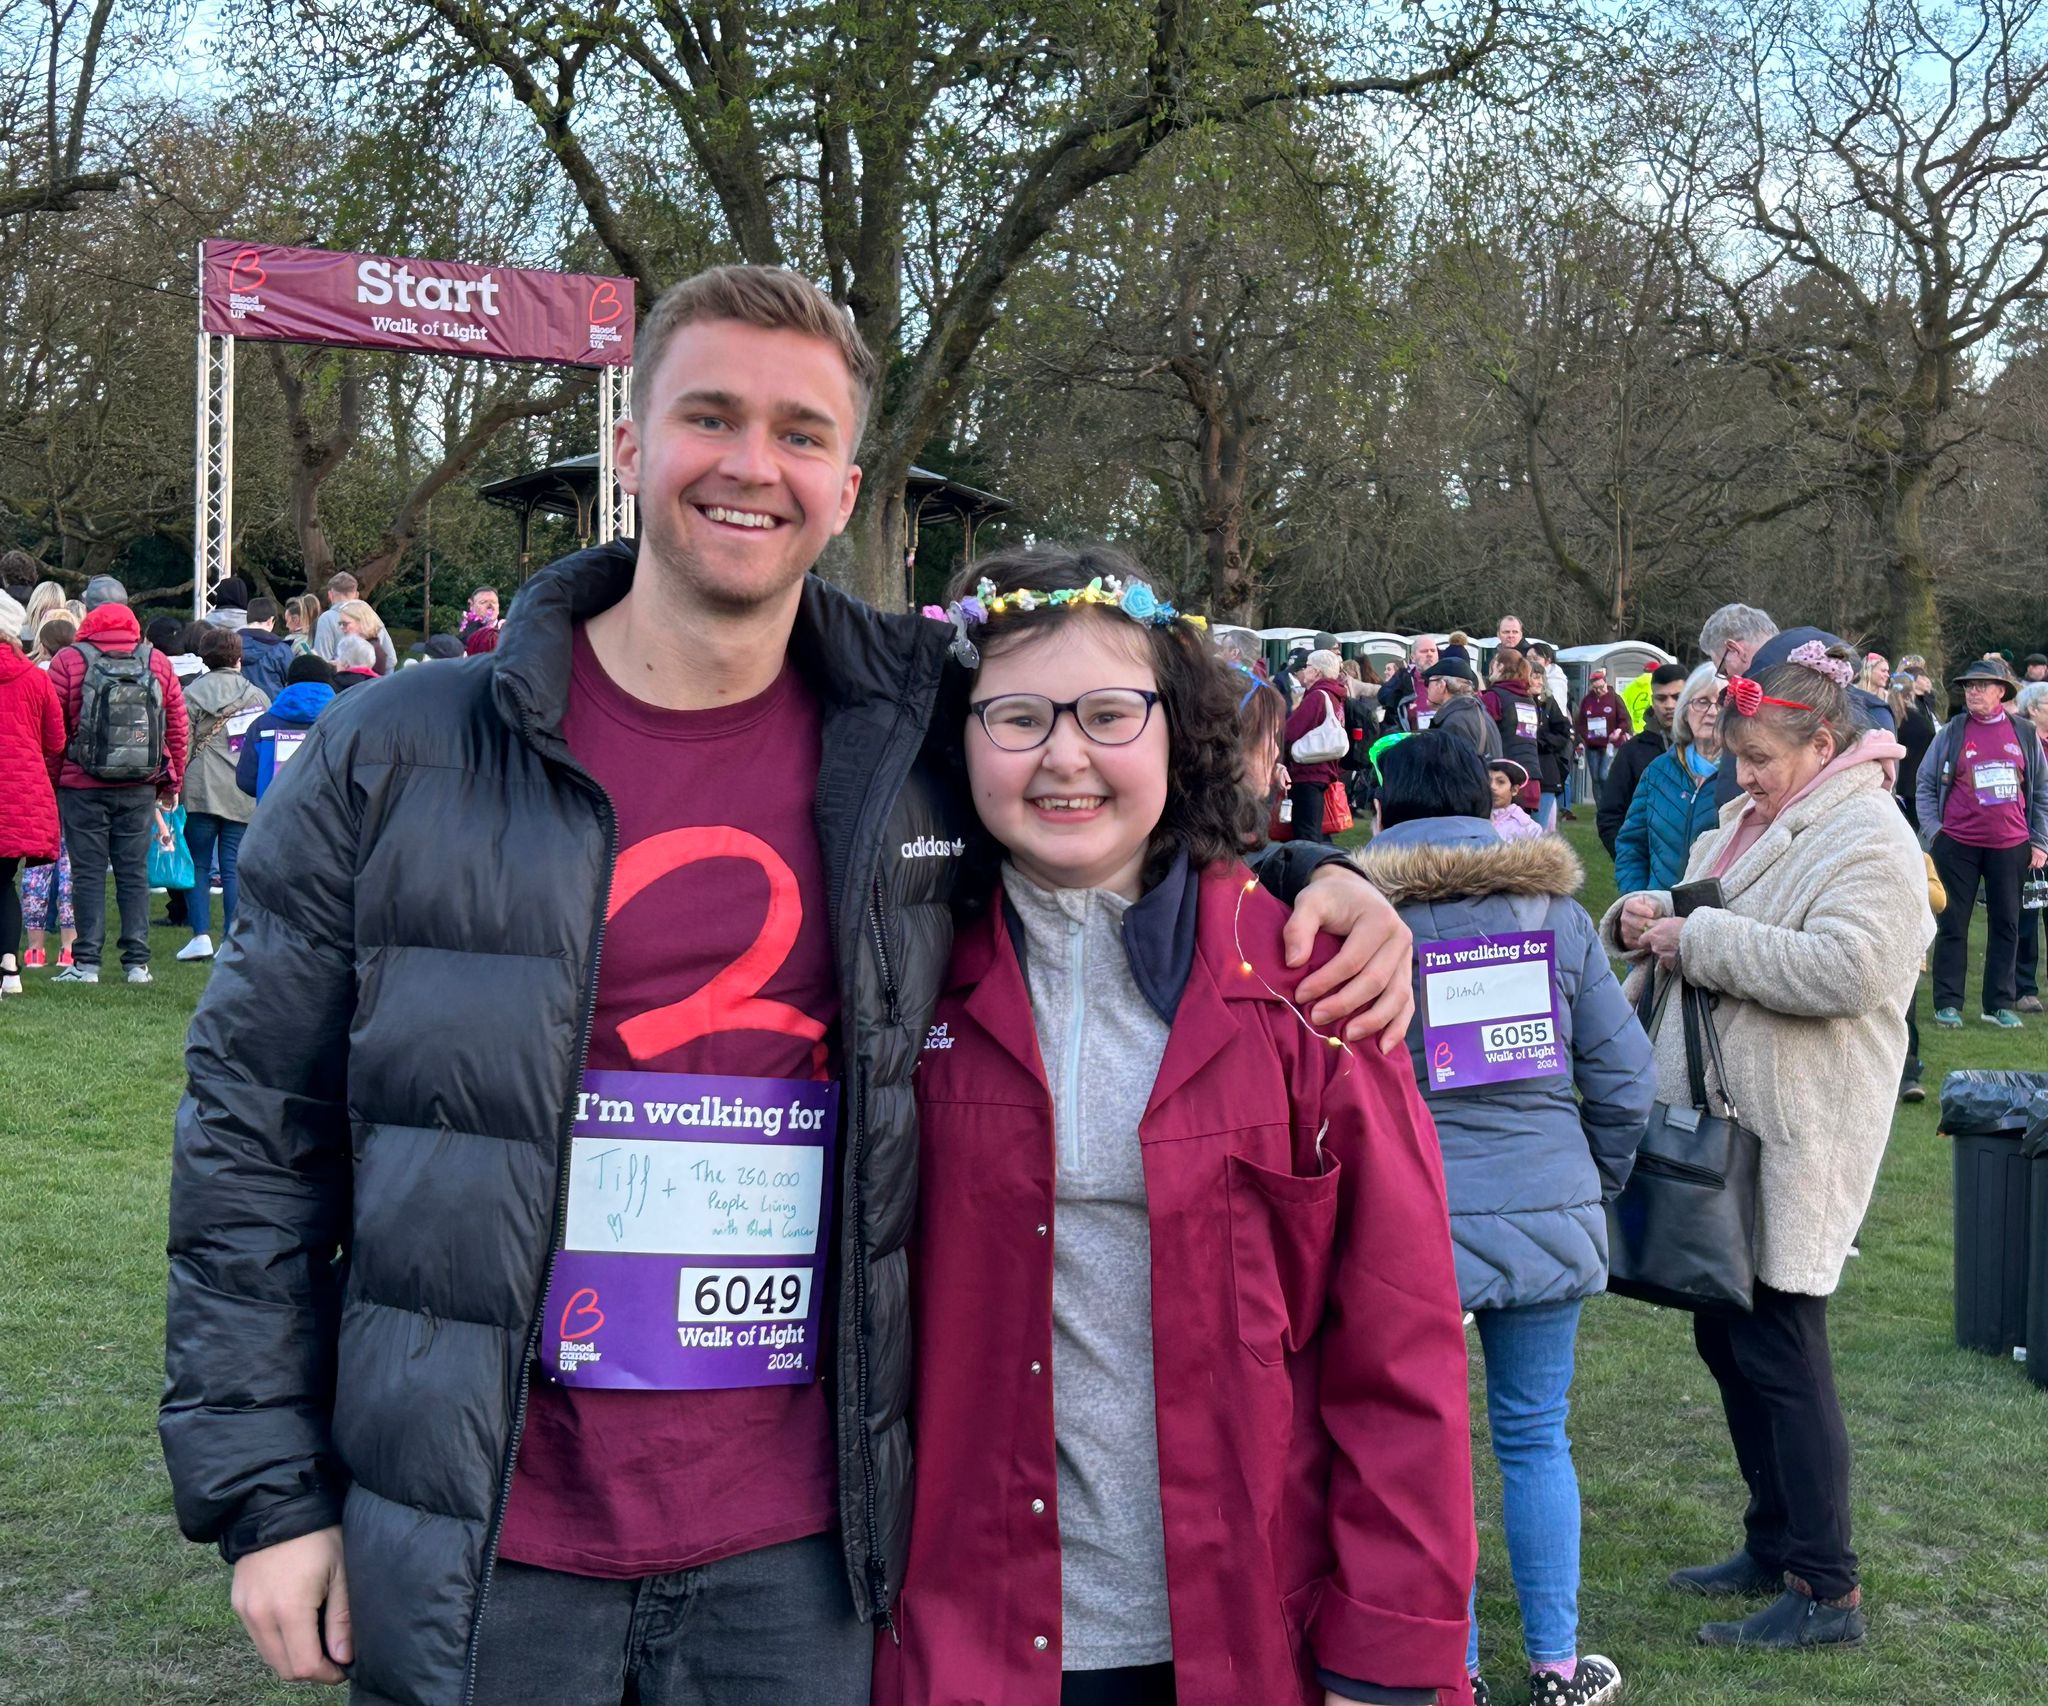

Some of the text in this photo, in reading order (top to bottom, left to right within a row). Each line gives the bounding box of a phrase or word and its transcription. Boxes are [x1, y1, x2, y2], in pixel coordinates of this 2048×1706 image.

[358, 260, 500, 316] Start
[229, 293, 259, 305] Blood
[230, 309, 246, 319] UK
[371, 316, 488, 342] Walk of Light
[590, 339, 605, 349] UK
[901, 834, 951, 858] adidas
[1425, 940, 1548, 967] I'm walking for
[1490, 1022, 1548, 1048] 6055
[1485, 1045, 1556, 1064] Walk of Light
[1537, 1058, 1558, 1069] 2024
[643, 1095, 784, 1136] walking
[788, 1100, 826, 1130] for
[587, 1147, 801, 1218] Tiff + The 250,000
[695, 1273, 802, 1316] 6049
[560, 1340, 594, 1352] Blood
[678, 1324, 805, 1349] Walk of Light
[560, 1351, 602, 1361] cancer
[560, 1360, 577, 1371] UK
[767, 1352, 803, 1371] 2024
